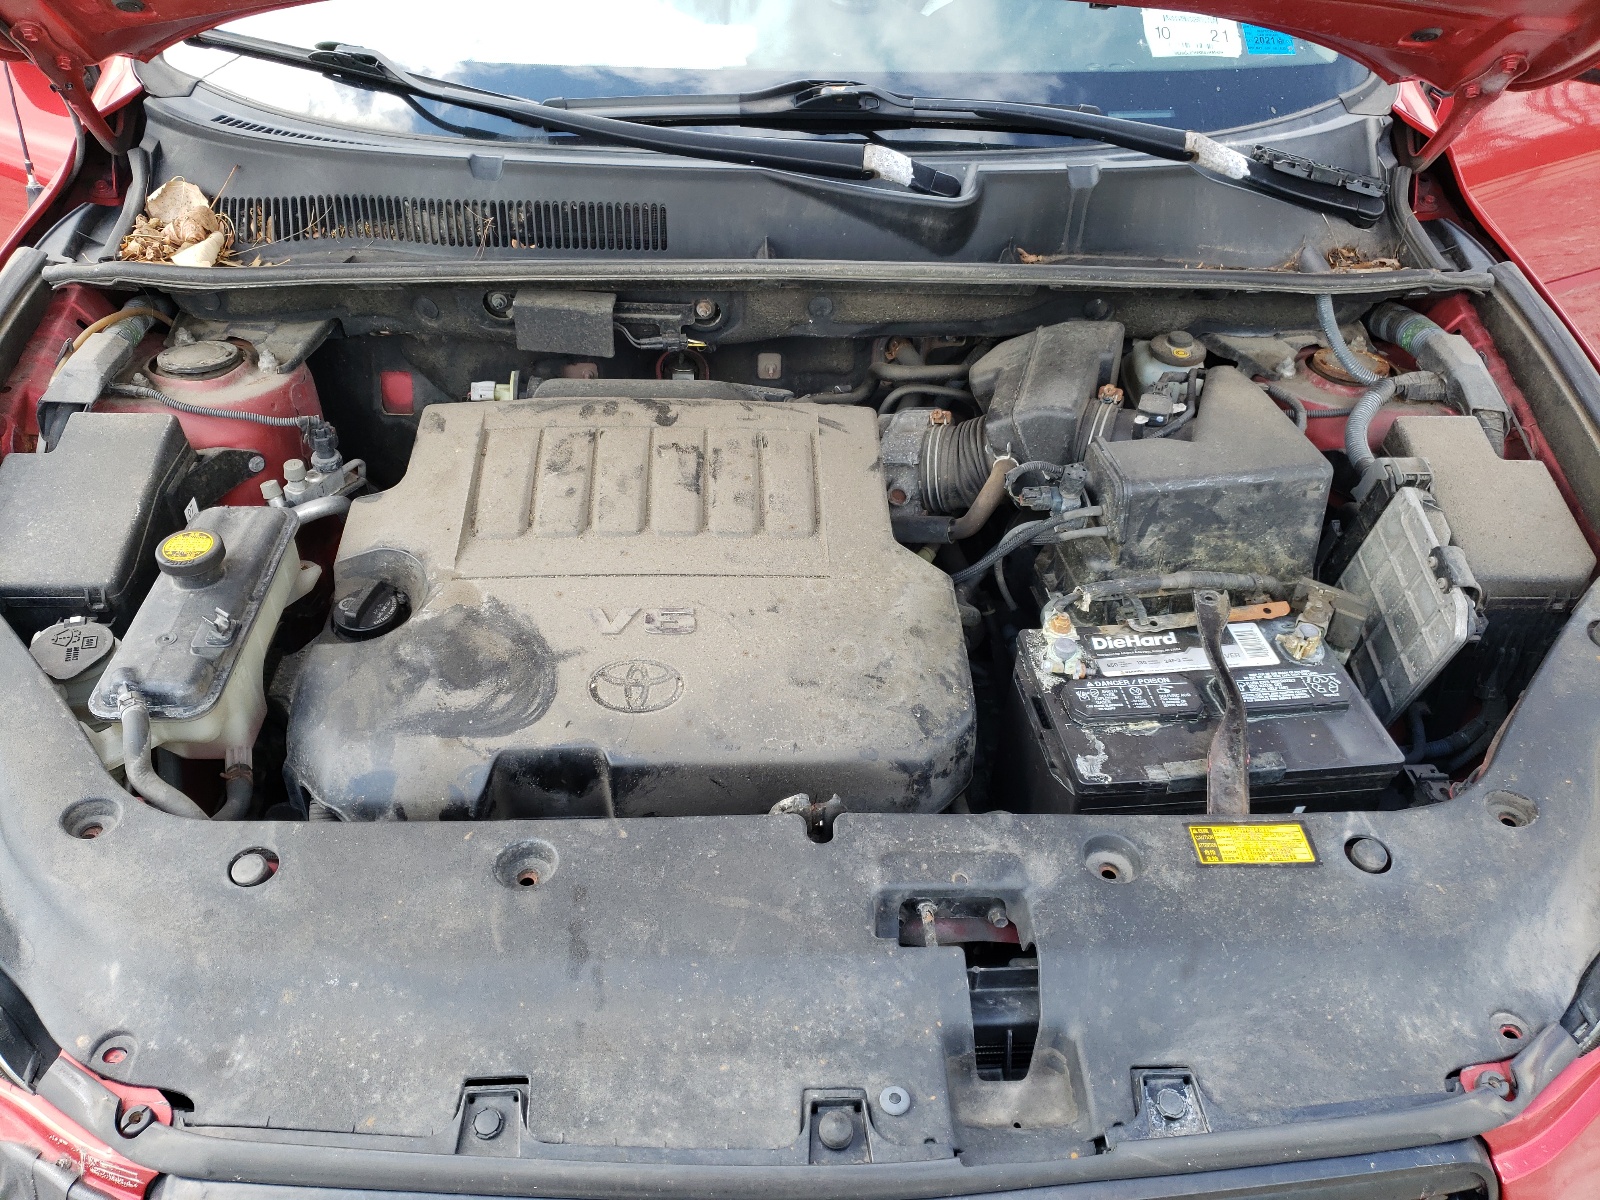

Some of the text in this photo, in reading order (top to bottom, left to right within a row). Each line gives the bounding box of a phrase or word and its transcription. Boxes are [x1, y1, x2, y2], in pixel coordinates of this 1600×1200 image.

[1155, 26, 1171, 40] 10
[1254, 36, 1275, 45] 2021
[584, 607, 697, 635] V6
[1092, 632, 1177, 650] DieHard
